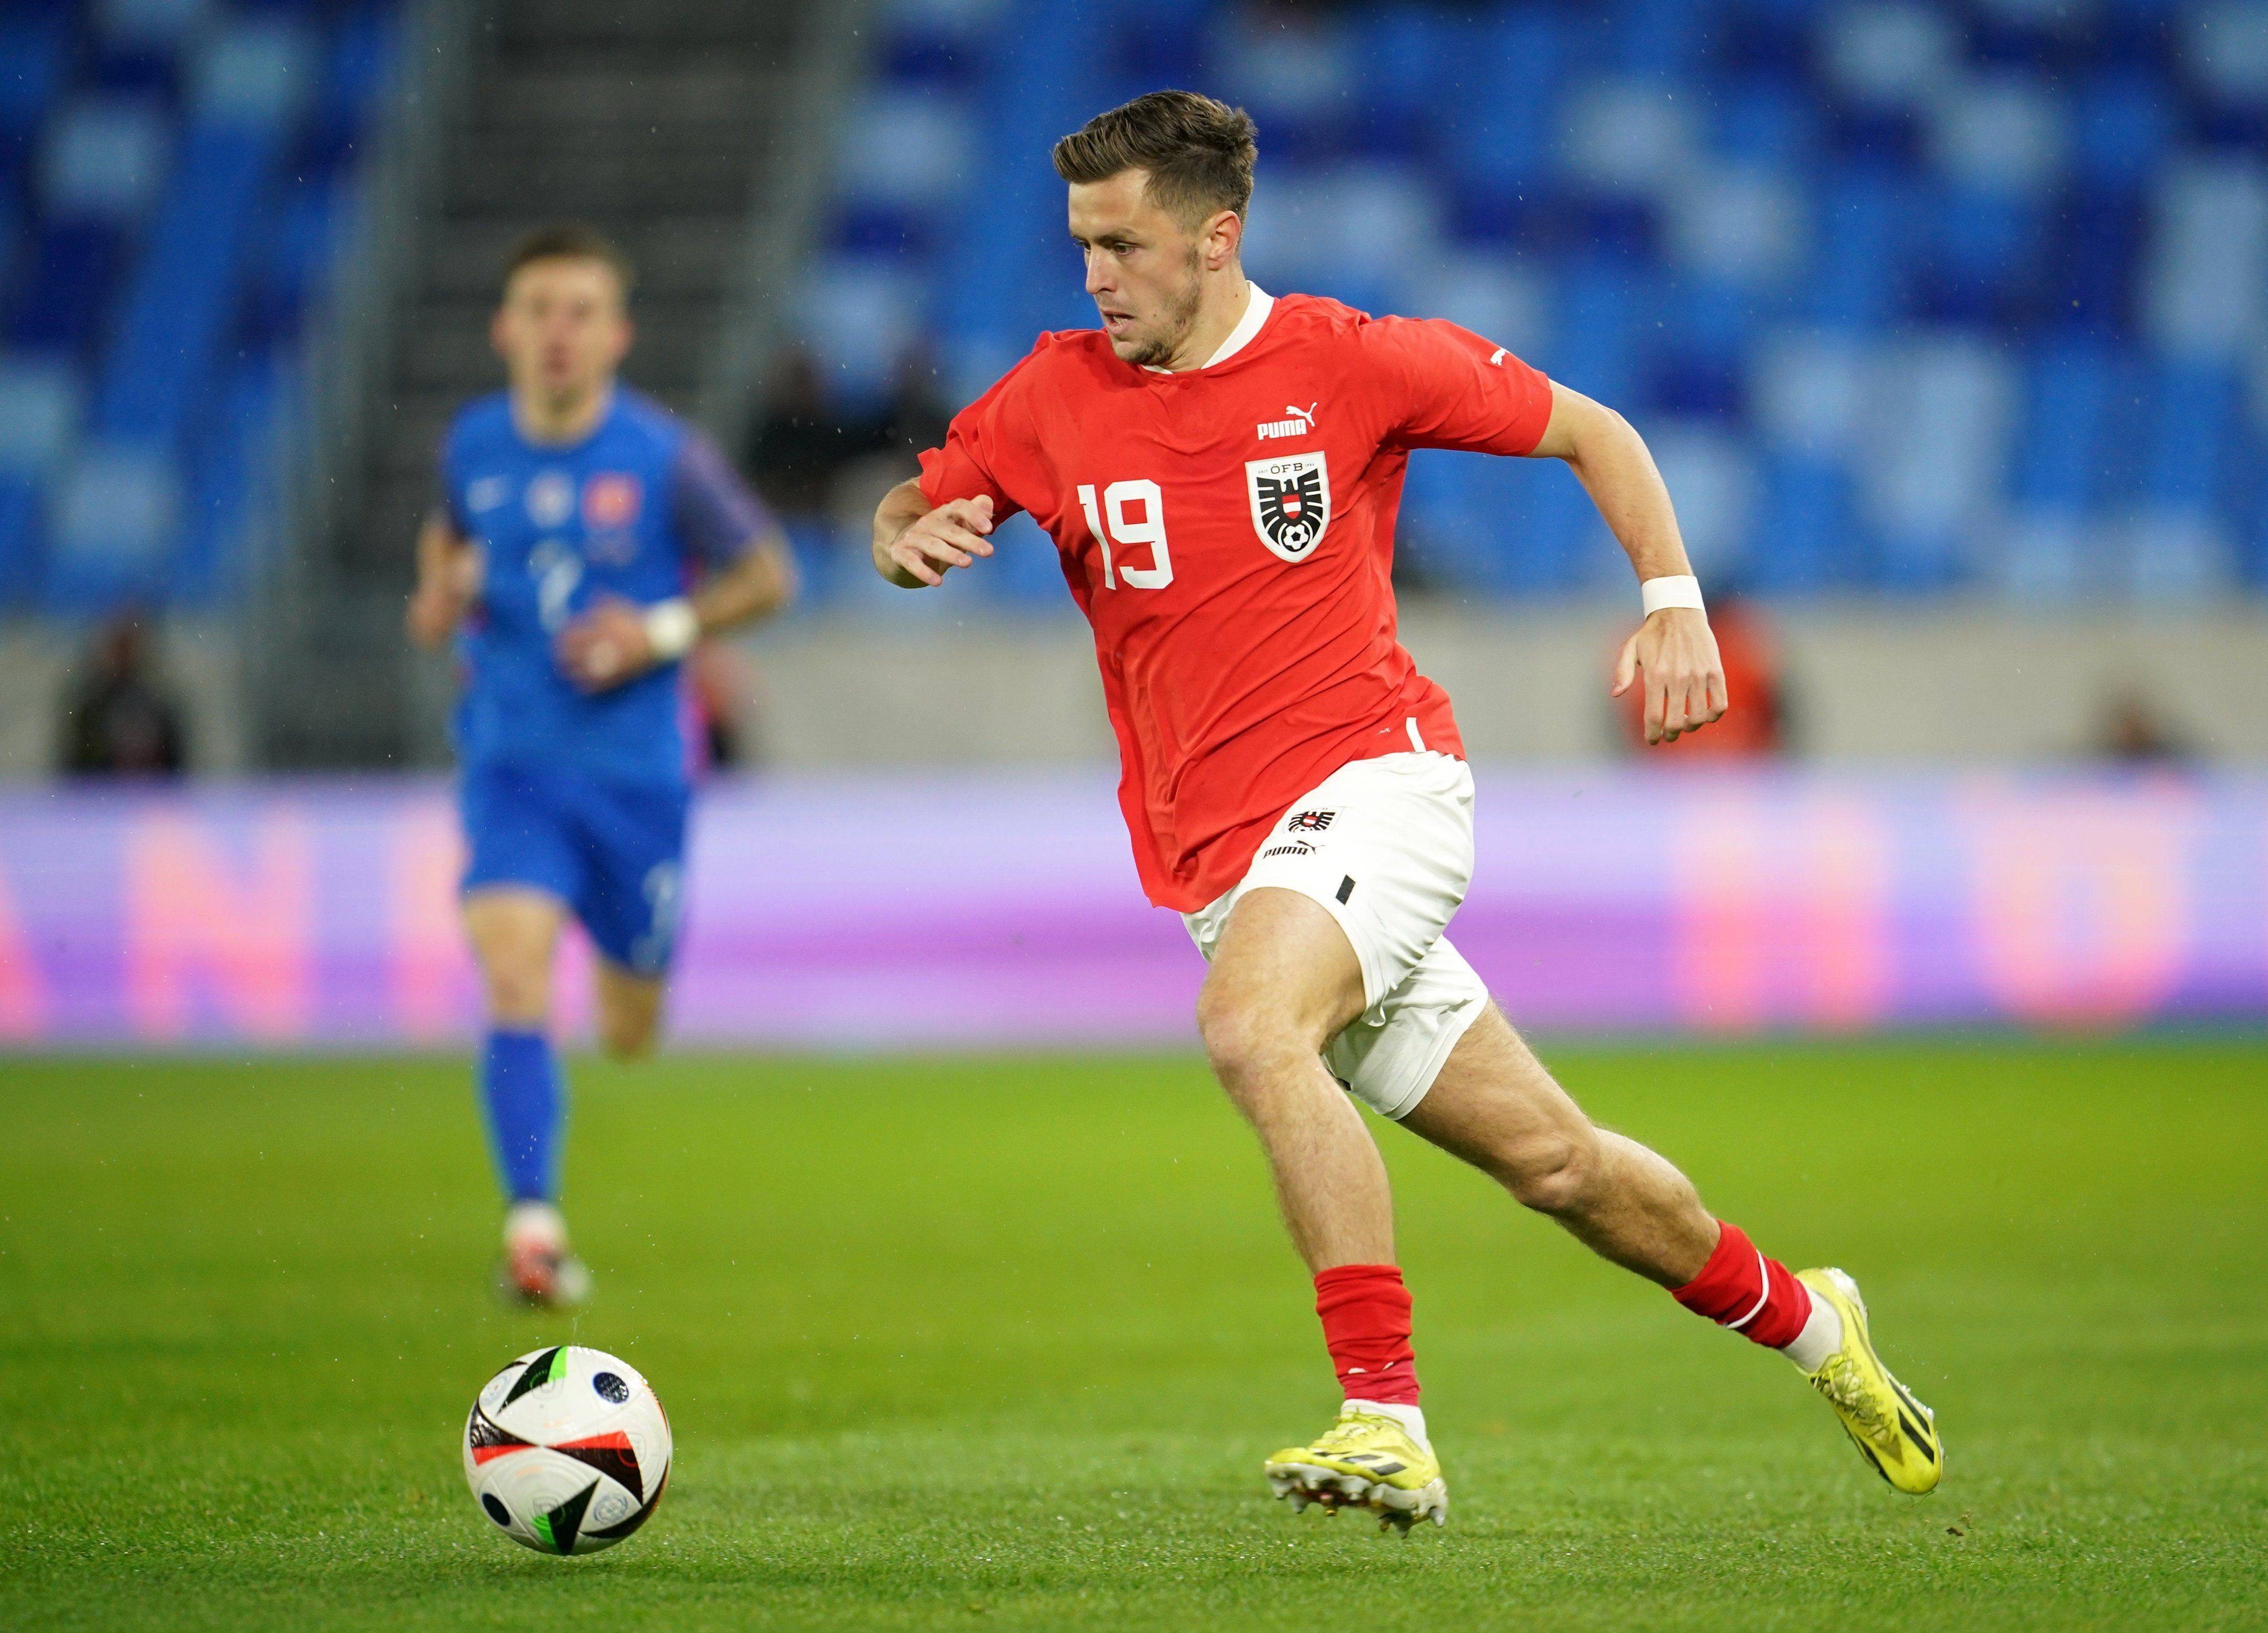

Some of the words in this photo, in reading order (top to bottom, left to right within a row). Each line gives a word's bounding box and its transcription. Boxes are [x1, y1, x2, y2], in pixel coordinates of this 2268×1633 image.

[1257, 419, 1307, 440] PUMA
[1270, 462, 1303, 474] ÖFB
[1076, 478, 1174, 591] 19
[1262, 846, 1308, 859] PUMA
